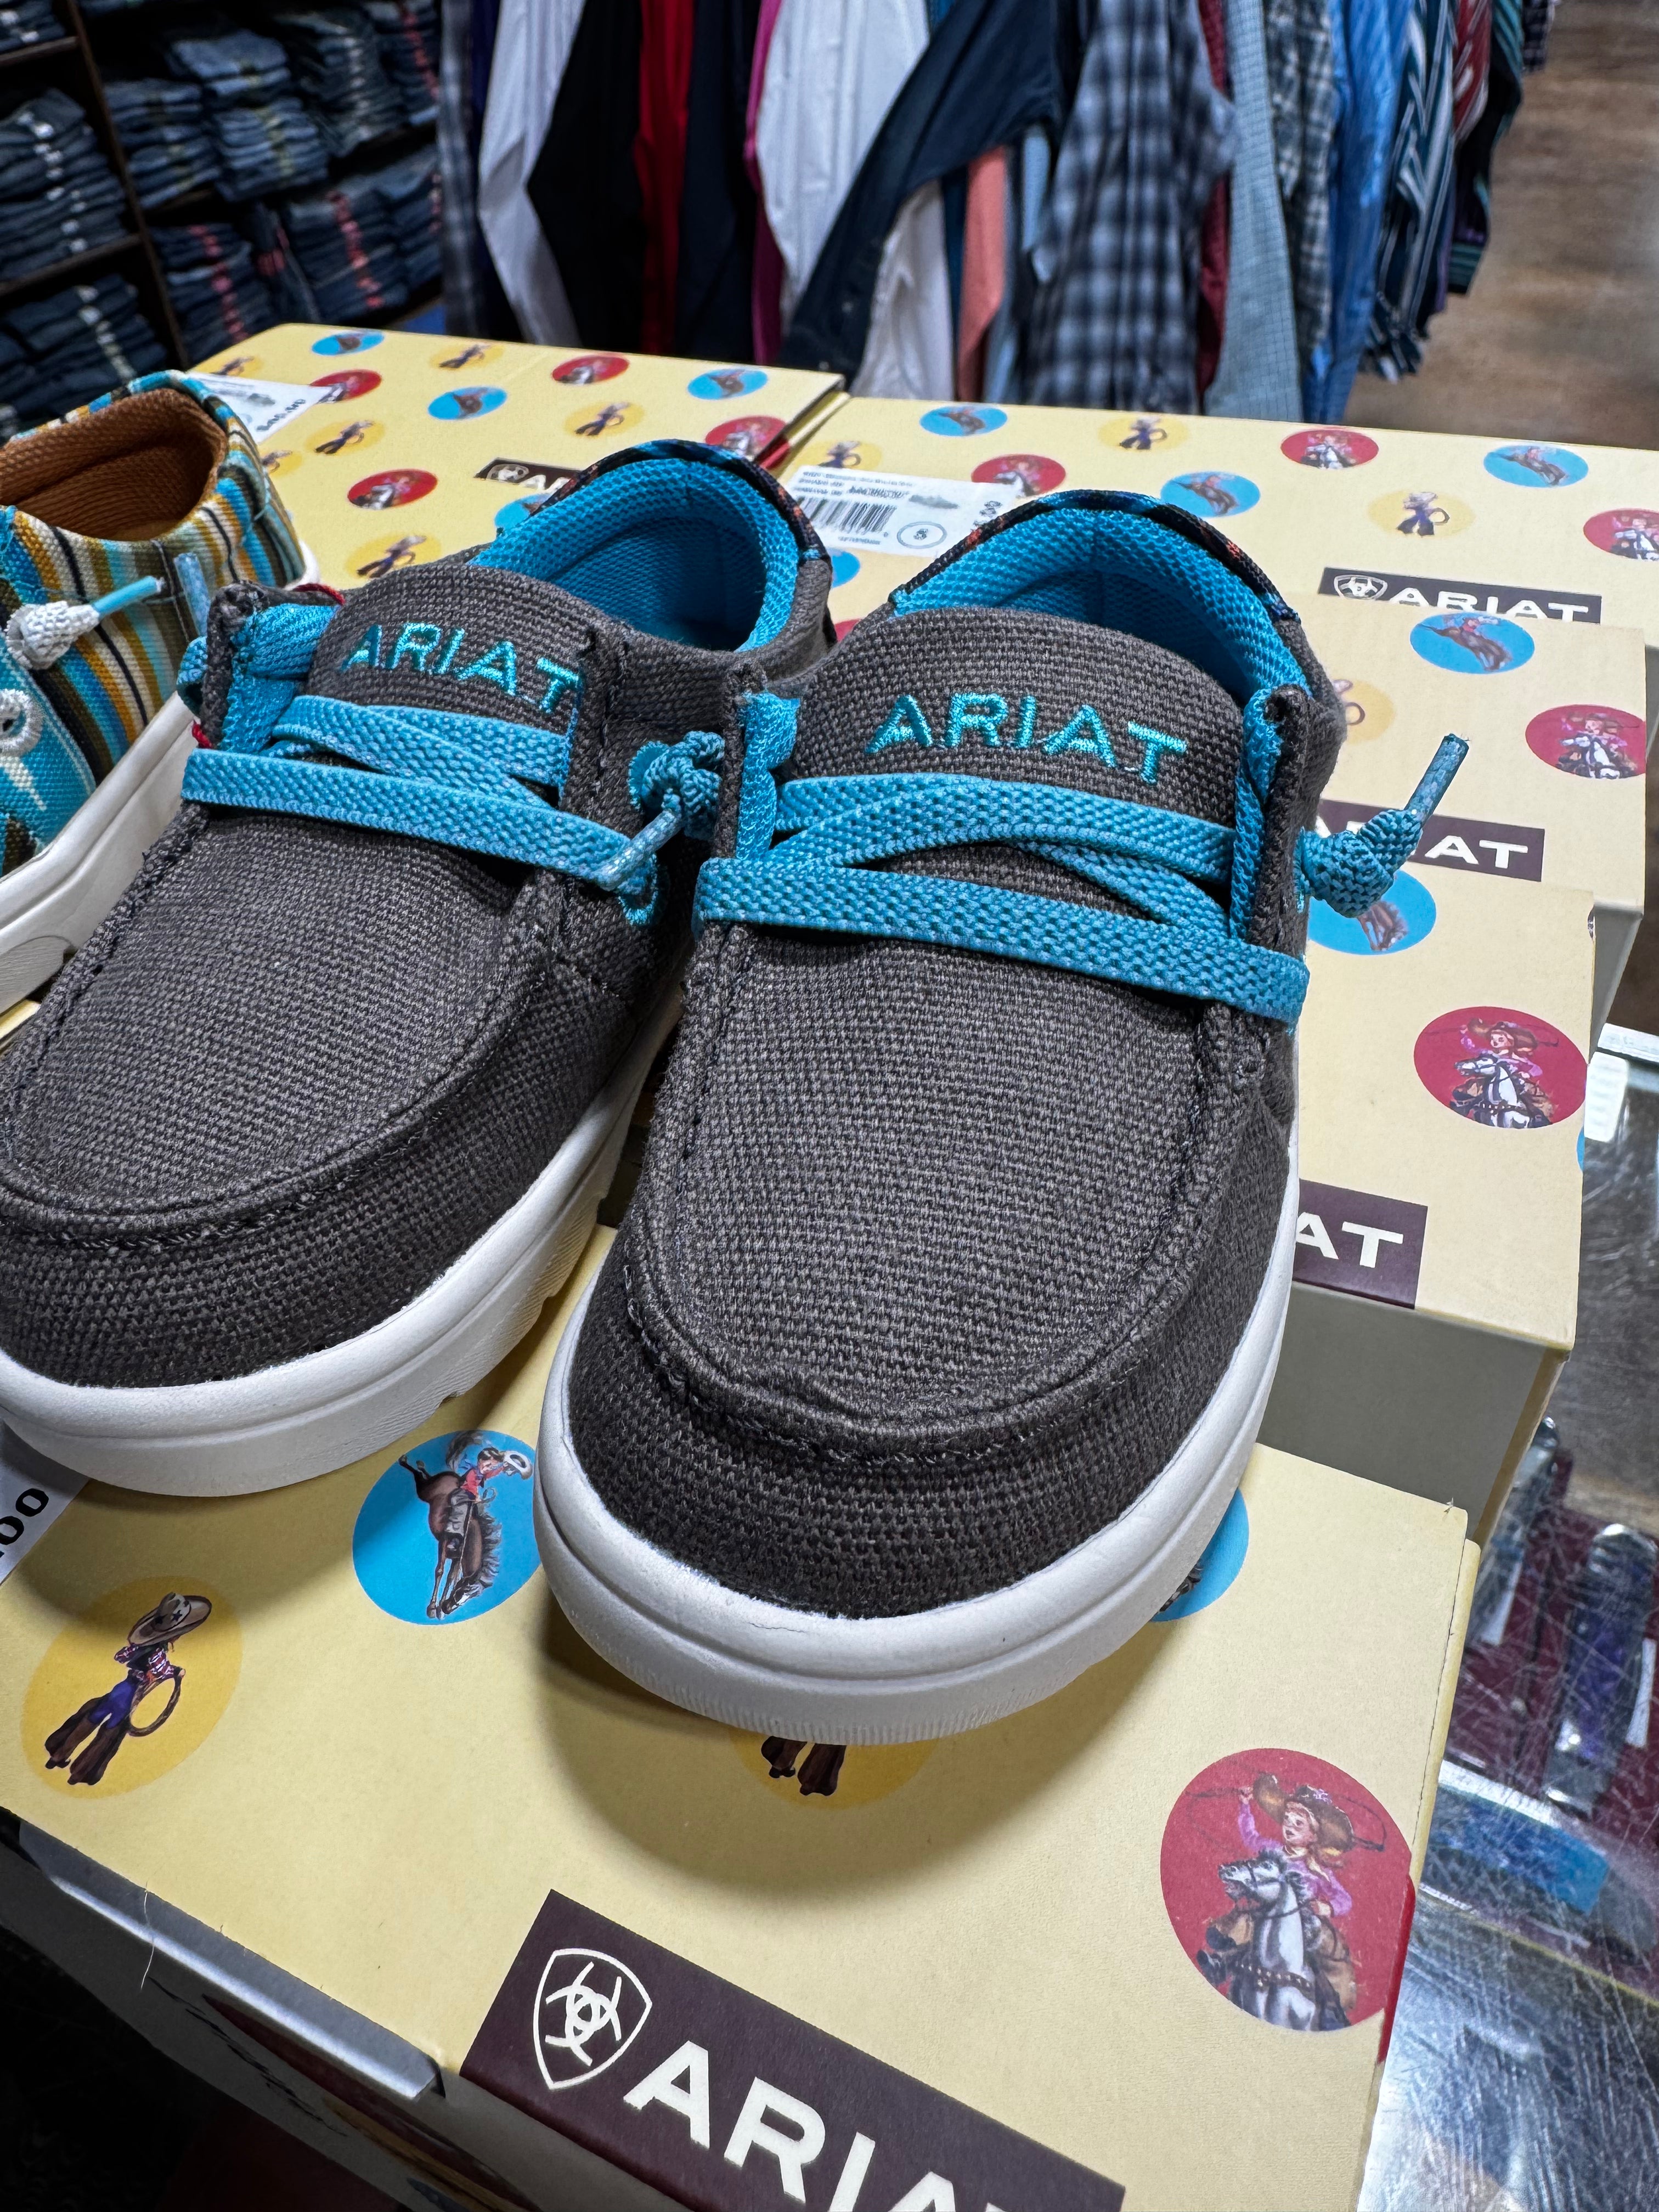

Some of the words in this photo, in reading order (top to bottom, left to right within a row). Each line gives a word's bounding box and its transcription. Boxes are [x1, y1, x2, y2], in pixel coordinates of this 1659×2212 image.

[1389, 588, 1588, 622] ARIAT
[340, 622, 579, 713] ARIAT
[865, 692, 1187, 784] ARIAT
[623, 2040, 1007, 2212] ARI
